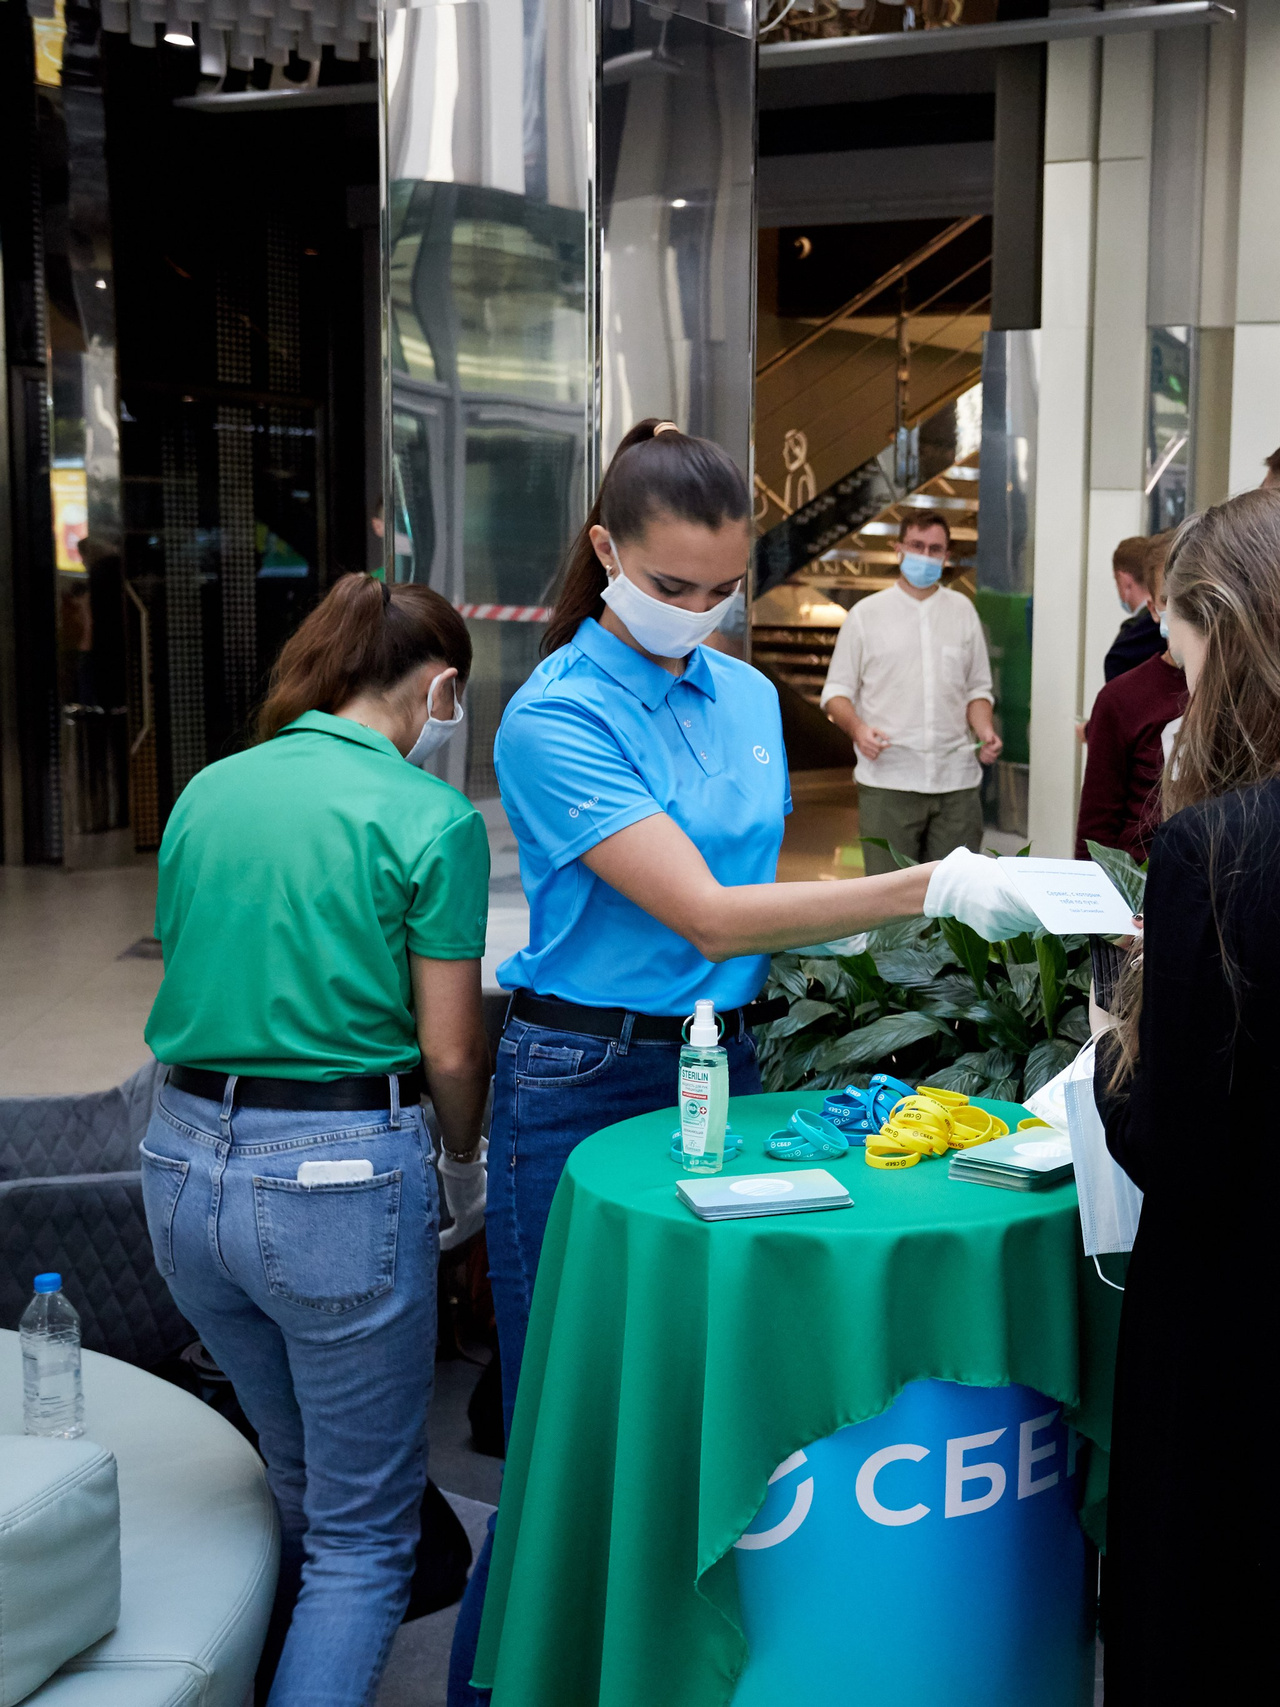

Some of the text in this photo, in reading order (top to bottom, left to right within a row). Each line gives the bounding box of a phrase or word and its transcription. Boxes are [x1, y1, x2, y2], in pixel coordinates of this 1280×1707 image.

[578, 796, 600, 812] СБЕР
[682, 1069, 709, 1082] STERILIN
[920, 1132, 934, 1140] СБЕР
